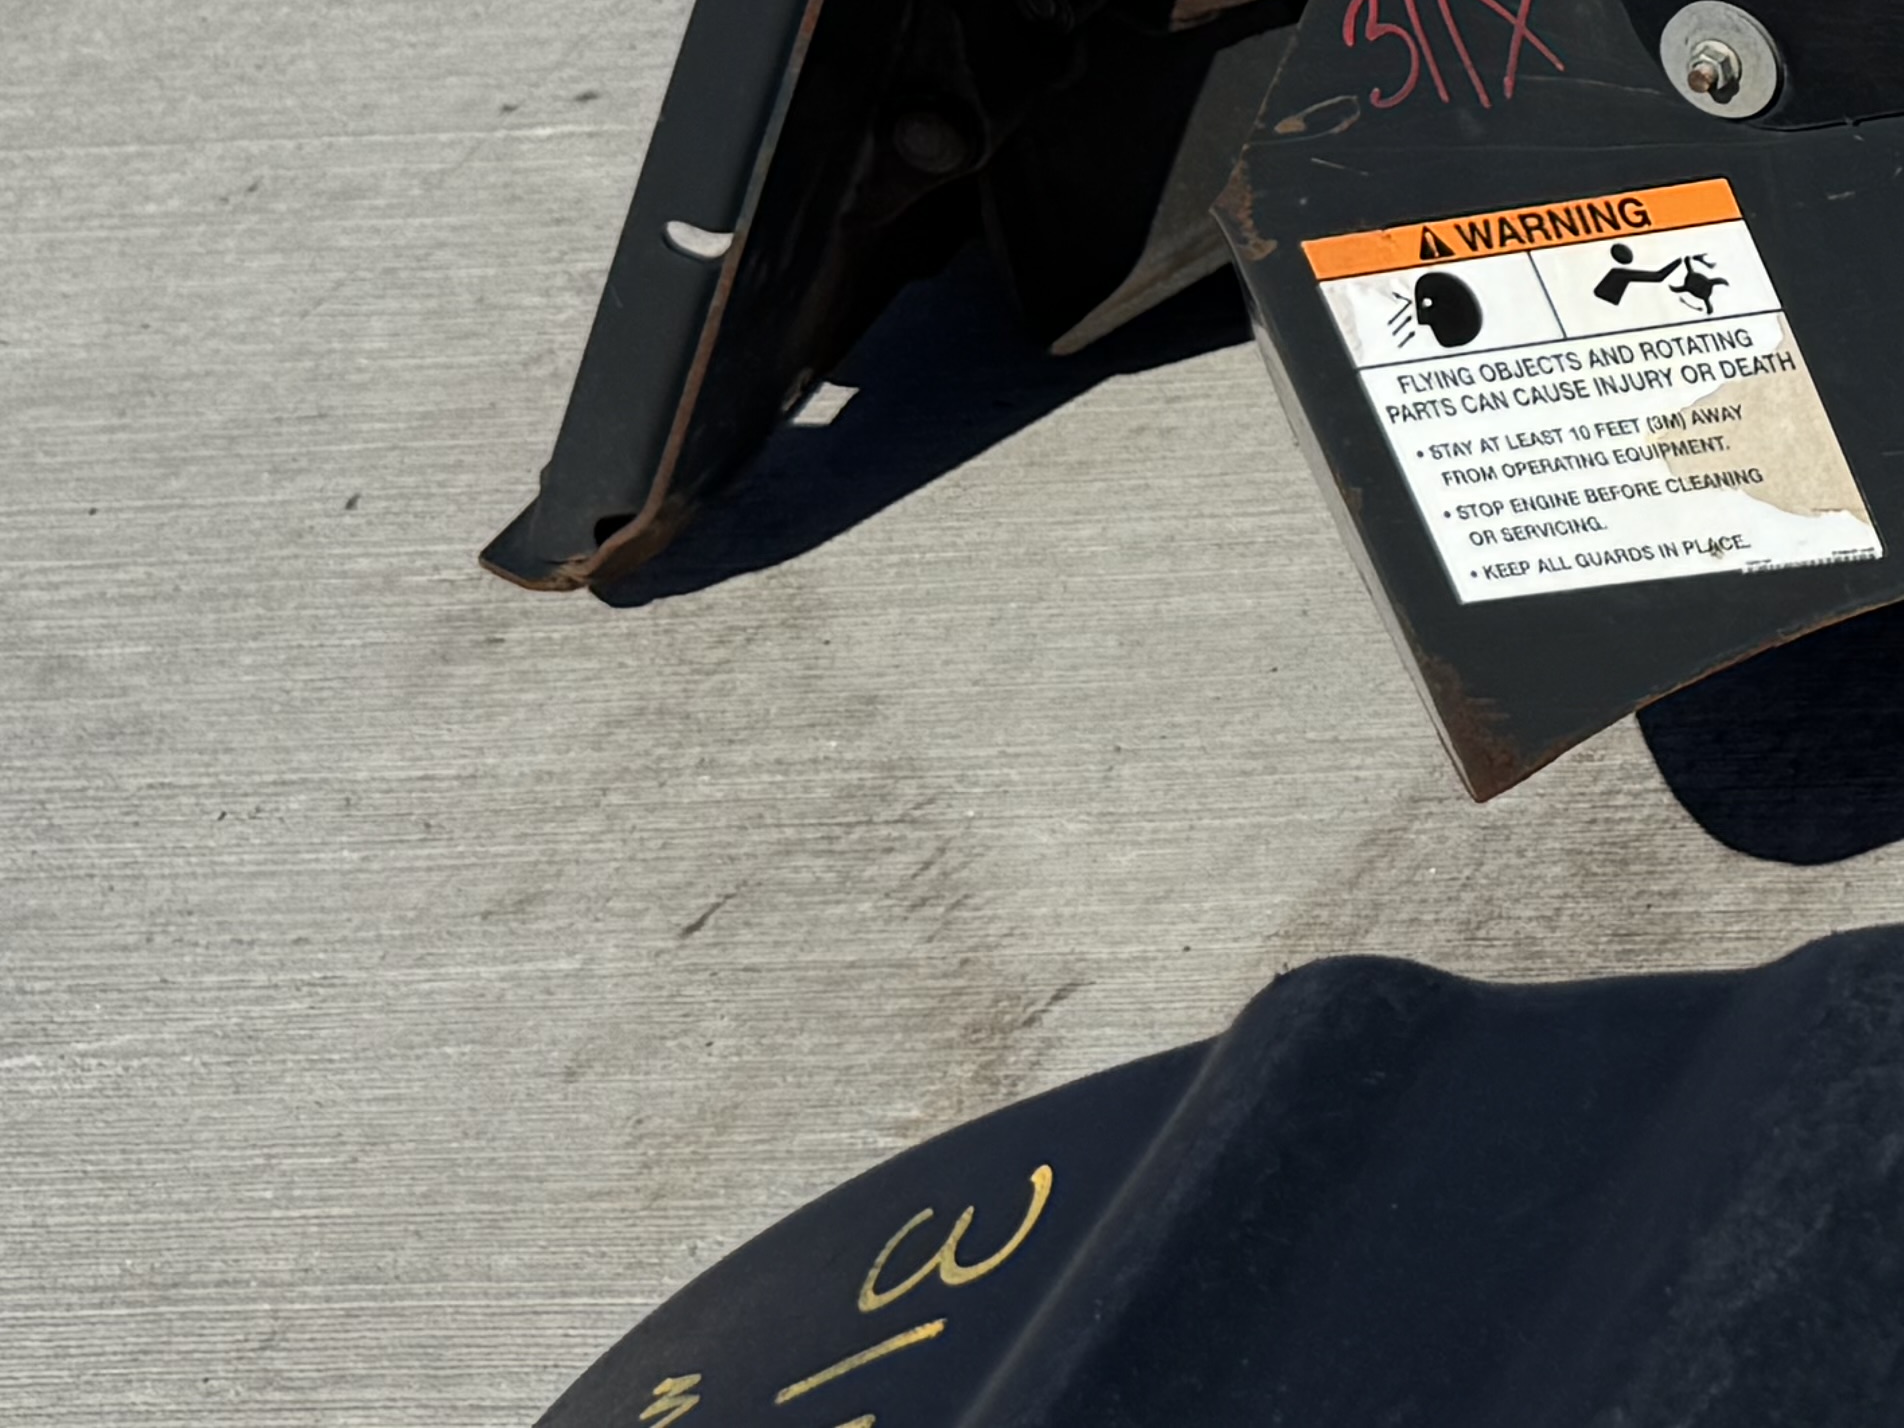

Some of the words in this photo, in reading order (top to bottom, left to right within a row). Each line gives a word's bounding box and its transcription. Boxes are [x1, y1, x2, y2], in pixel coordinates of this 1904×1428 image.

[1454, 197, 1652, 253] WARNING
[1386, 398, 1457, 424] PARTS
[1461, 390, 1510, 413] CAN
[1515, 379, 1590, 407] CAUSE
[1593, 367, 1673, 397] INJURY
[1680, 362, 1716, 384] OR
[1719, 351, 1797, 380] DEATH
[1397, 367, 1476, 394] FLYING
[1479, 352, 1582, 382] OBJECTS
[1589, 344, 1635, 369] AND
[1639, 328, 1754, 362] ROTATING
[1429, 440, 1473, 460] STAY
[1480, 436, 1501, 454] AT
[1505, 428, 1564, 451] LEAST
[1570, 424, 1591, 442] 10
[1594, 418, 1641, 439] FEET
[1646, 411, 1688, 434] (3M)
[1692, 404, 1743, 426] AWAY
[1441, 465, 1498, 486] FROM
[1502, 451, 1609, 479] OPERATING
[1613, 435, 1731, 465] EQUIPMENT.
[1456, 500, 1504, 520] STOP
[1509, 490, 1581, 514] ENGINE
[1584, 480, 1662, 504] BEFORE
[1665, 467, 1764, 494] CLEANING
[1469, 529, 1498, 546] OR
[1501, 516, 1608, 543] SERVICING.
[1482, 560, 1530, 580] KEEP
[1538, 555, 1572, 574] ALL
[1575, 544, 1655, 569] GUARDS
[1658, 542, 1680, 559] IN
